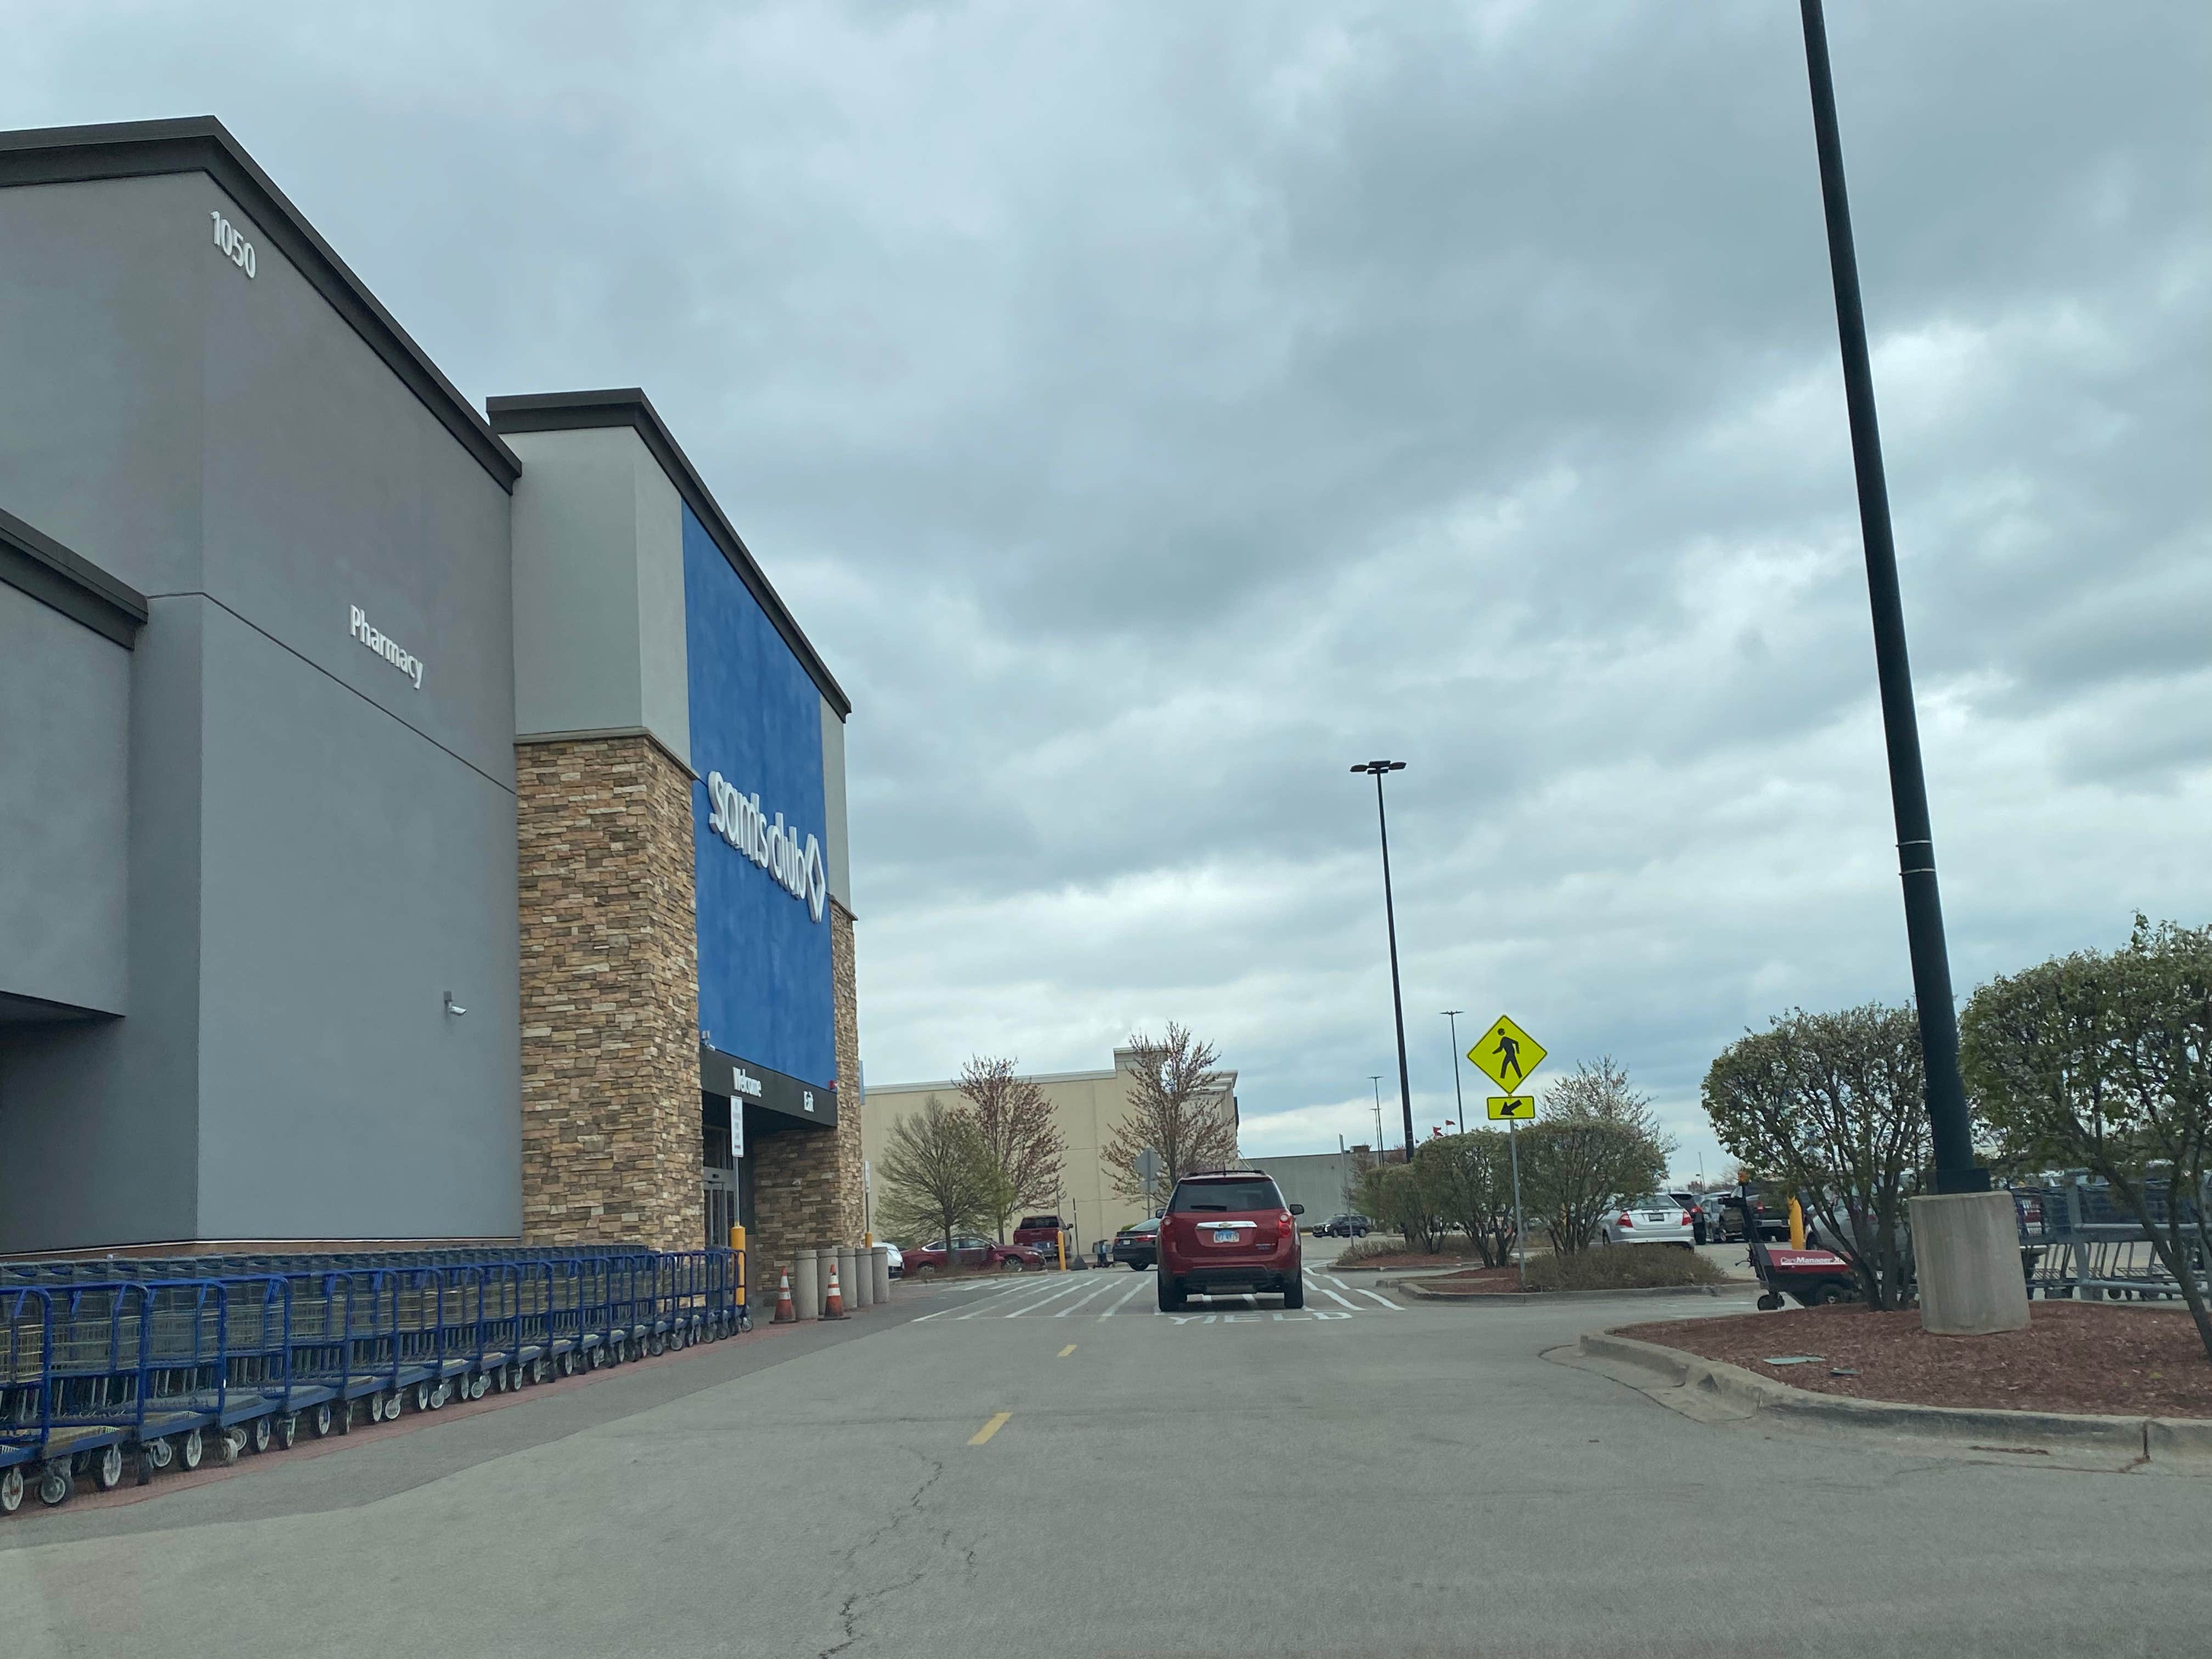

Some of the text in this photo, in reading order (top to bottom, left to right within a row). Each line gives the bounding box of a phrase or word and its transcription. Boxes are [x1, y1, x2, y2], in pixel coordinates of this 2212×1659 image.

[210, 211, 256, 278] 1050
[350, 605, 424, 690] Pharmacy
[766, 812, 806, 900] club
[732, 1066, 761, 1098] Welcome
[1167, 1312, 1353, 1325] YIELD
